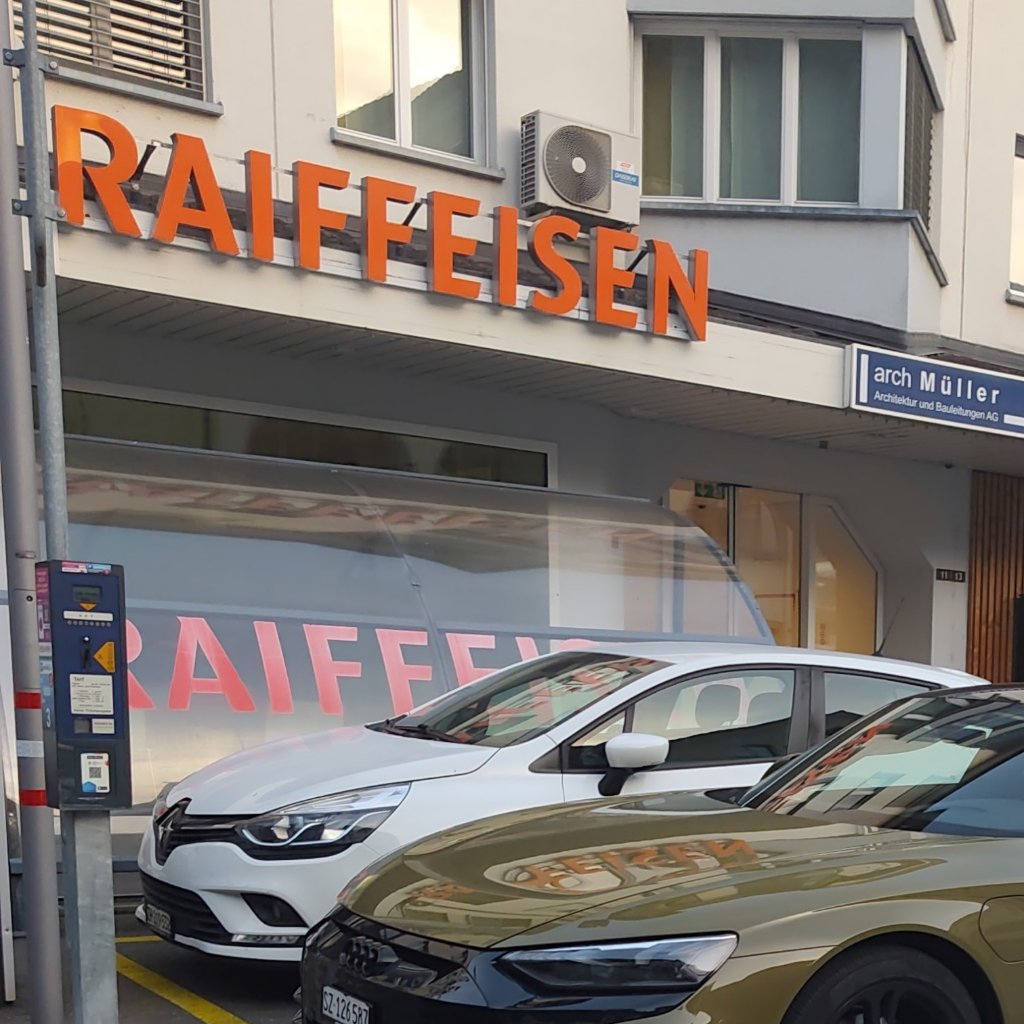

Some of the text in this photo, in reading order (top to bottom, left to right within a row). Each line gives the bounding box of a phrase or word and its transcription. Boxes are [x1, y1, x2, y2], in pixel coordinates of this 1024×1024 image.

[52, 105, 709, 341] RAIFFEISEN
[874, 367, 1000, 404] arch Müller
[873, 390, 999, 422] Architektur und Bauleitungen AG
